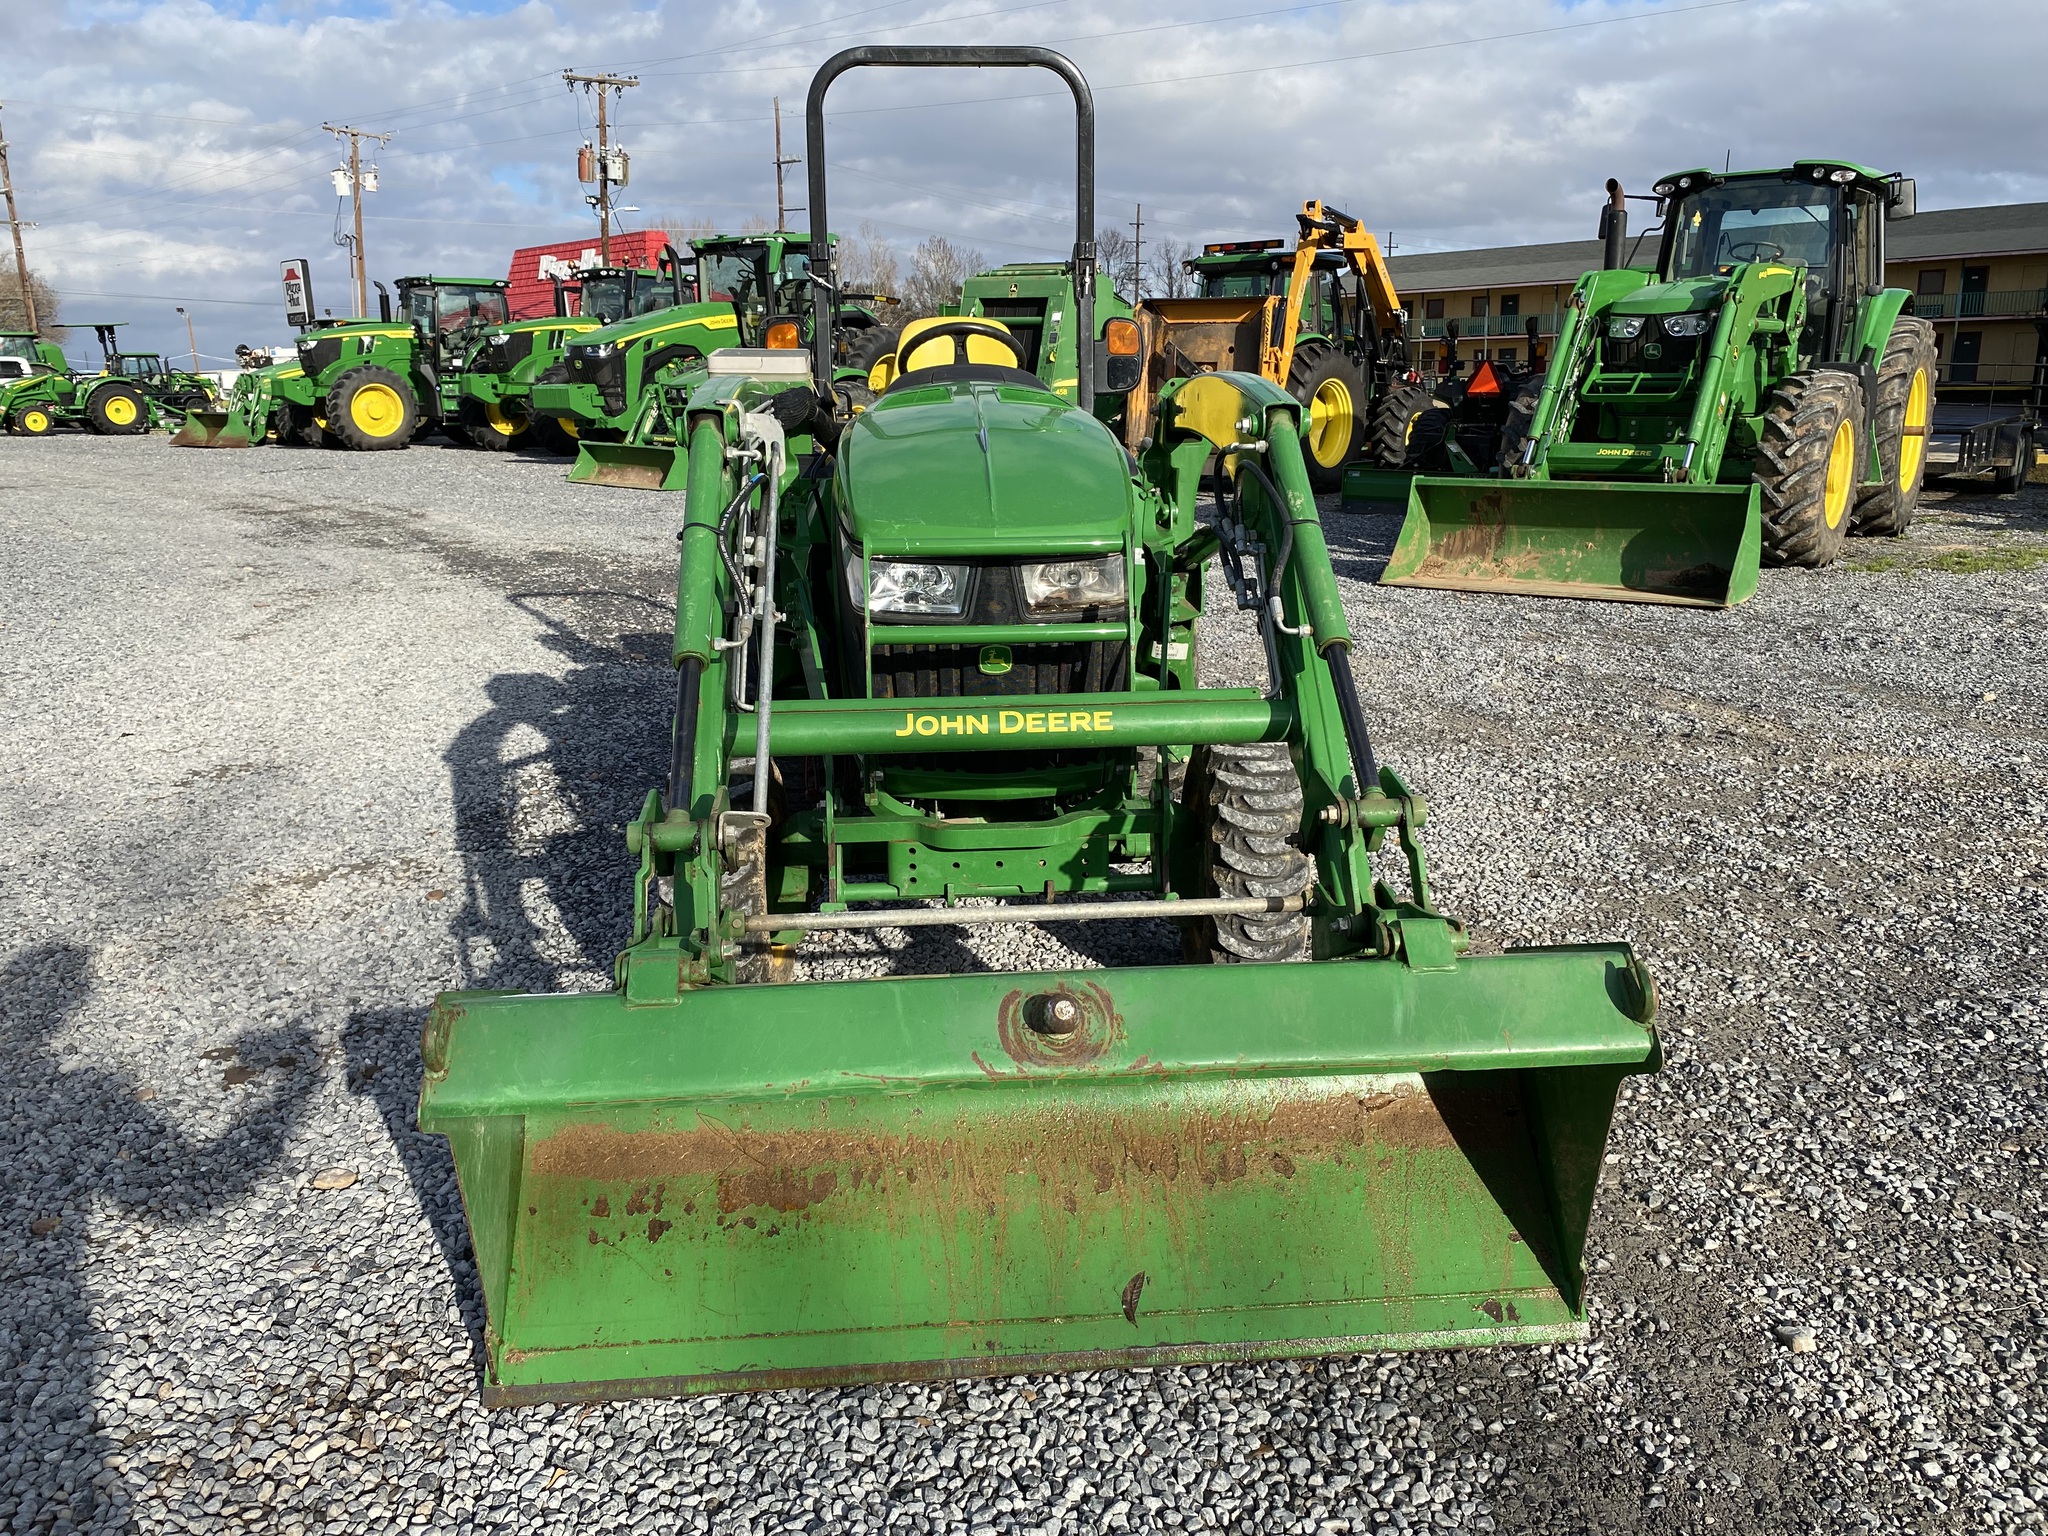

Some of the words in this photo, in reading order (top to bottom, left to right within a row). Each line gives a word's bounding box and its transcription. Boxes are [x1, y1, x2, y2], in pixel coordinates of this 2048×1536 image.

[580, 248, 611, 270] Hu
[285, 281, 301, 295] Pizza
[287, 294, 301, 307] Hut
[1596, 448, 1621, 456] JOHN
[1621, 448, 1652, 456] DEERE
[895, 713, 989, 737] JOHN
[999, 710, 1114, 734] DEERE
